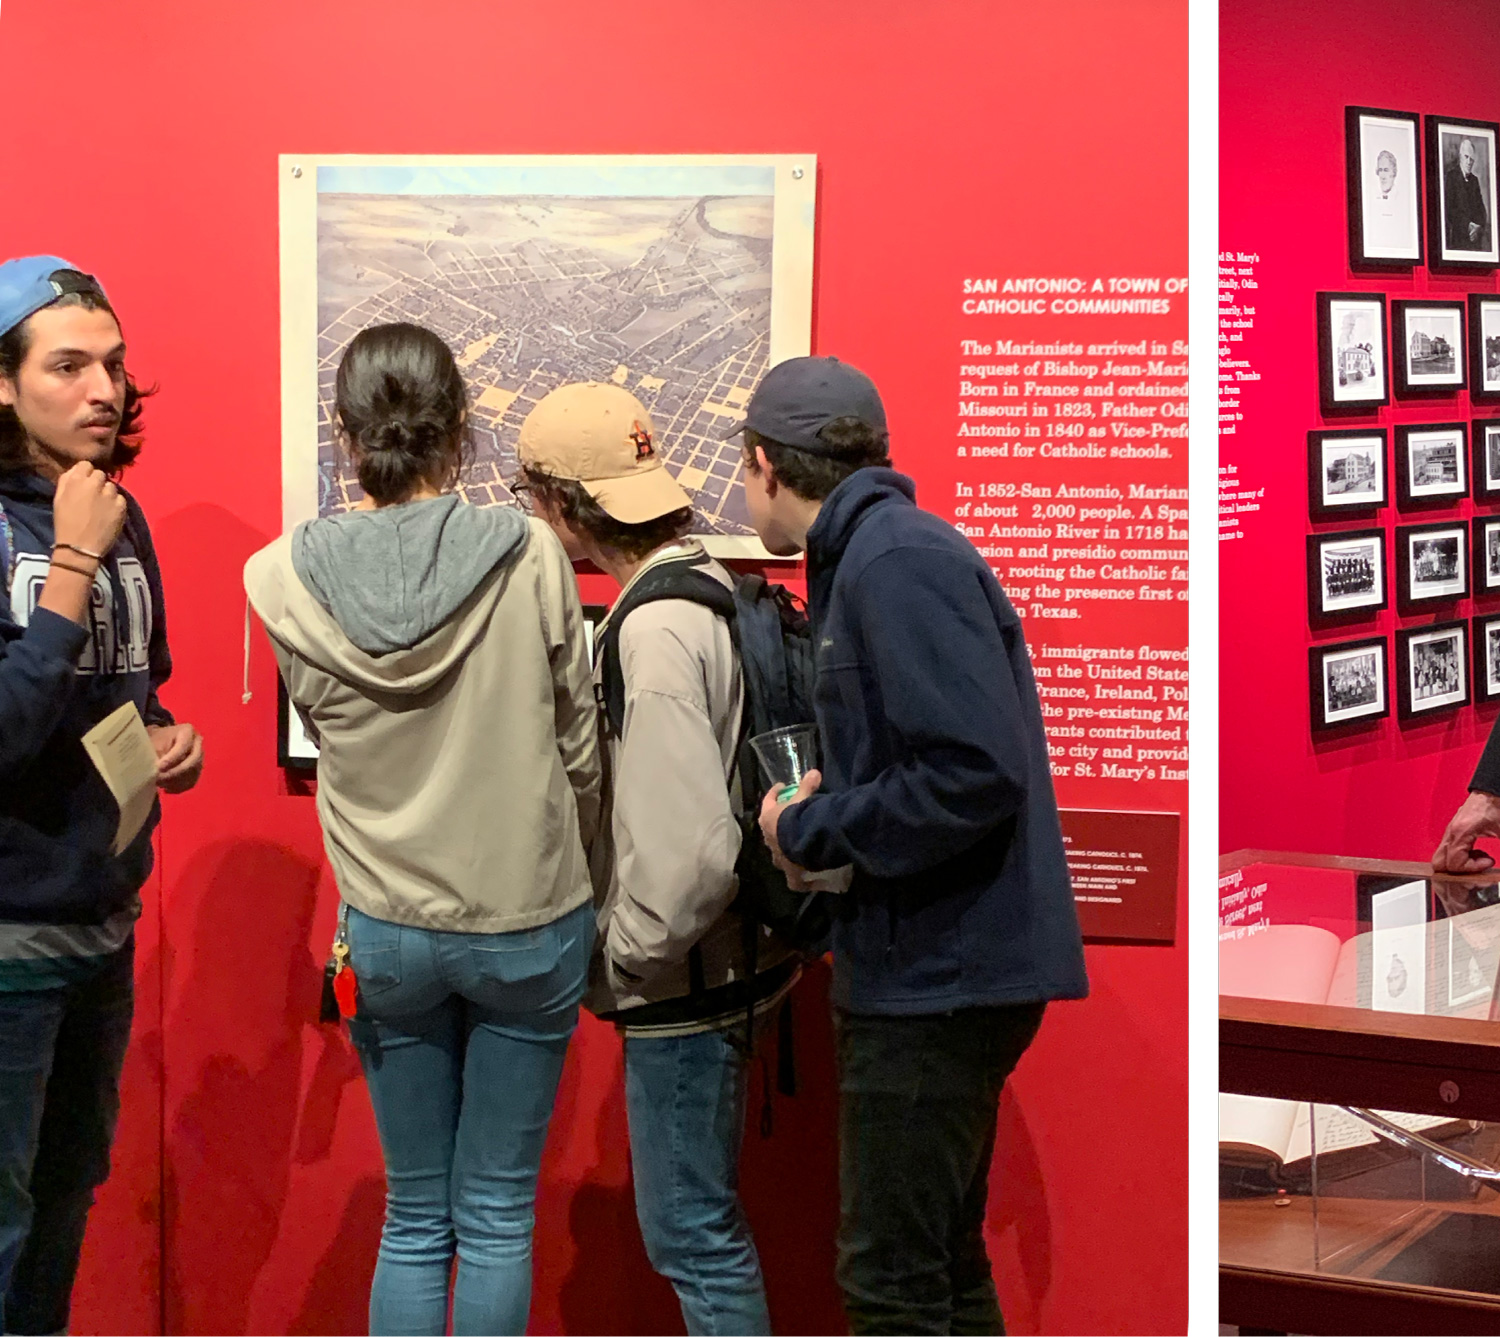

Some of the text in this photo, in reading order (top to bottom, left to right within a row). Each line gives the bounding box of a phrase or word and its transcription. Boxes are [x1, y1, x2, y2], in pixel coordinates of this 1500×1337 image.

[963, 278, 1188, 293] SAN ANTONIO: A TOWN OF
[1242, 279, 1258, 288] Odin
[963, 299, 1170, 314] CATHOLIC COMMUNITIES
[1220, 319, 1253, 328] the school
[961, 341, 991, 356] The
[996, 341, 1083, 356] Marianists
[1087, 341, 1146, 356] arrived
[1152, 341, 1167, 356] in
[960, 362, 1019, 377] request
[1024, 361, 1039, 376] of
[1044, 361, 1097, 380] Bishop
[1235, 371, 1260, 381] Thanks
[960, 382, 1188, 397] Born in France and ordained
[959, 403, 1027, 417] Missouri
[1033, 403, 1048, 417] in
[1054, 403, 1097, 419] 1823,
[1102, 403, 1155, 417] Father
[958, 423, 1019, 437] Antonio
[1025, 423, 1040, 437] in
[1046, 423, 1084, 437] 1840
[1088, 426, 1106, 437] as
[629, 429, 654, 459] H
[958, 443, 1172, 459] a need for Catholic schools.
[956, 484, 973, 497] In
[979, 484, 1050, 498] 1852-San
[1056, 484, 1124, 501] Antonio,
[956, 503, 971, 517] of
[974, 504, 1018, 518] about
[1032, 504, 1075, 519] 2,000
[1080, 504, 1135, 522] people.
[1141, 506, 1153, 519] A
[956, 523, 984, 537] San
[990, 523, 1051, 538] Antonio
[1056, 524, 1098, 539] River
[1104, 525, 1119, 539] in
[1125, 526, 1163, 540] 1718
[1019, 544, 1048, 558] and
[1053, 545, 1116, 562] presidio
[1009, 564, 1166, 582] rooting the Catholic
[1035, 585, 1173, 603] the presence first
[1030, 605, 1081, 619] Texas.
[1042, 644, 1188, 662] immigrants flowed
[1056, 666, 1082, 678] the
[1088, 666, 1142, 679] United
[1095, 685, 1157, 702] Ireland,
[1068, 706, 1162, 723] pre-existing
[1089, 726, 1181, 741] contributed
[1069, 746, 1097, 761] city
[1103, 747, 1132, 758] and
[1075, 765, 1096, 778] St.
